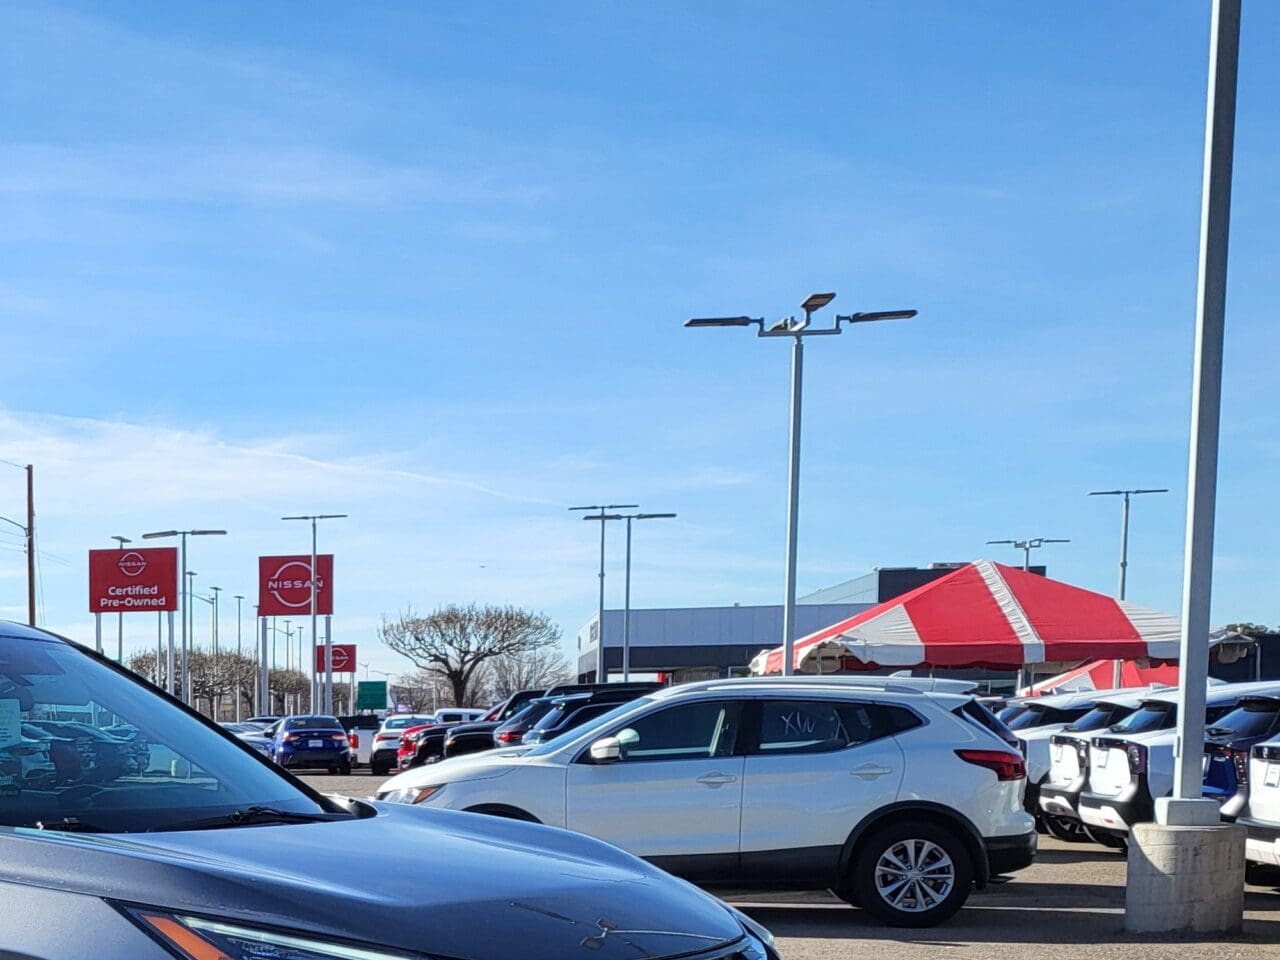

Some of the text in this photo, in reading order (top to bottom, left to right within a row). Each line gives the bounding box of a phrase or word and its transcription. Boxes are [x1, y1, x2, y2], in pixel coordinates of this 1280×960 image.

[268, 580, 324, 589] NISSAN
[108, 585, 158, 596] Certified
[100, 596, 166, 607] Pre-Owned
